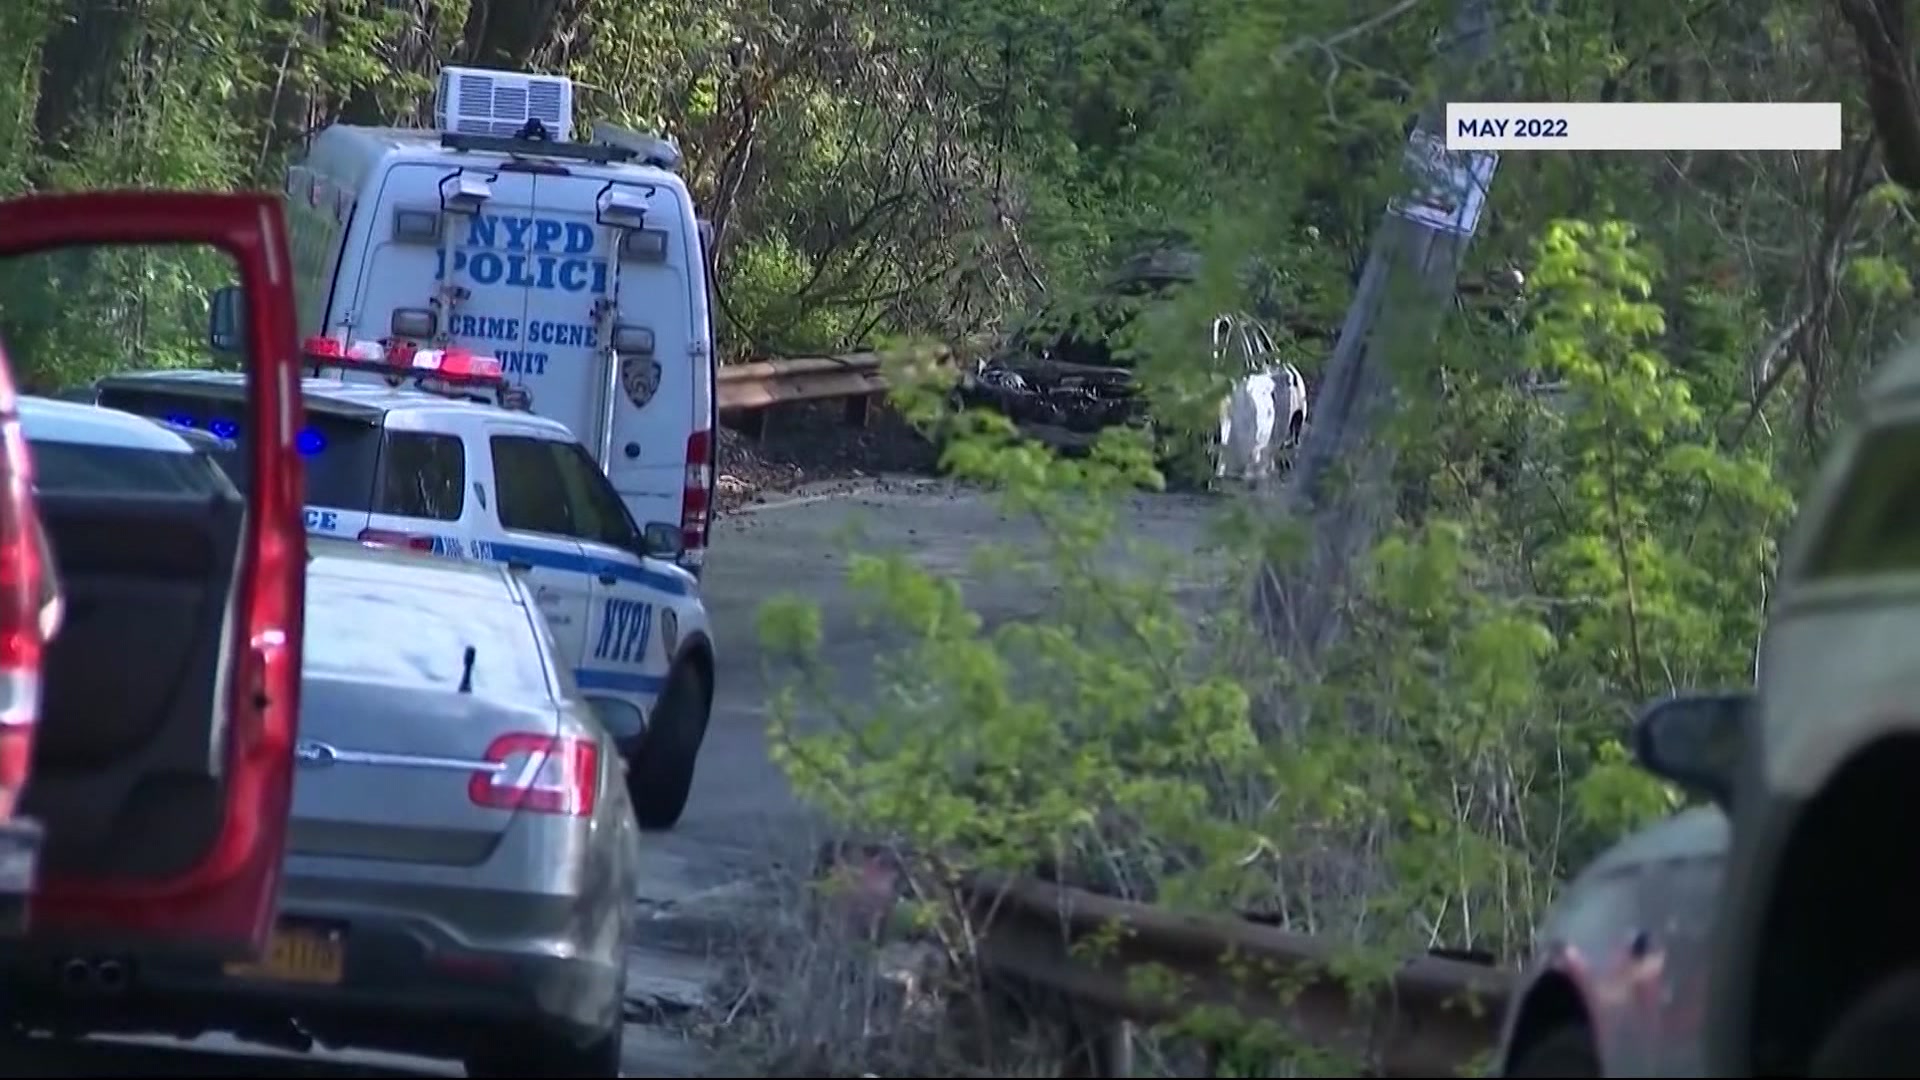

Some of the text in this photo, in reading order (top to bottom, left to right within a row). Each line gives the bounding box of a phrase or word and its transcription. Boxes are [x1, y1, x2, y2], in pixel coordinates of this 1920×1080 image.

[467, 214, 594, 253] NYPD
[450, 314, 599, 347] CRIME SCENE
[494, 350, 549, 375] UNIT
[594, 597, 653, 662] NYPD
